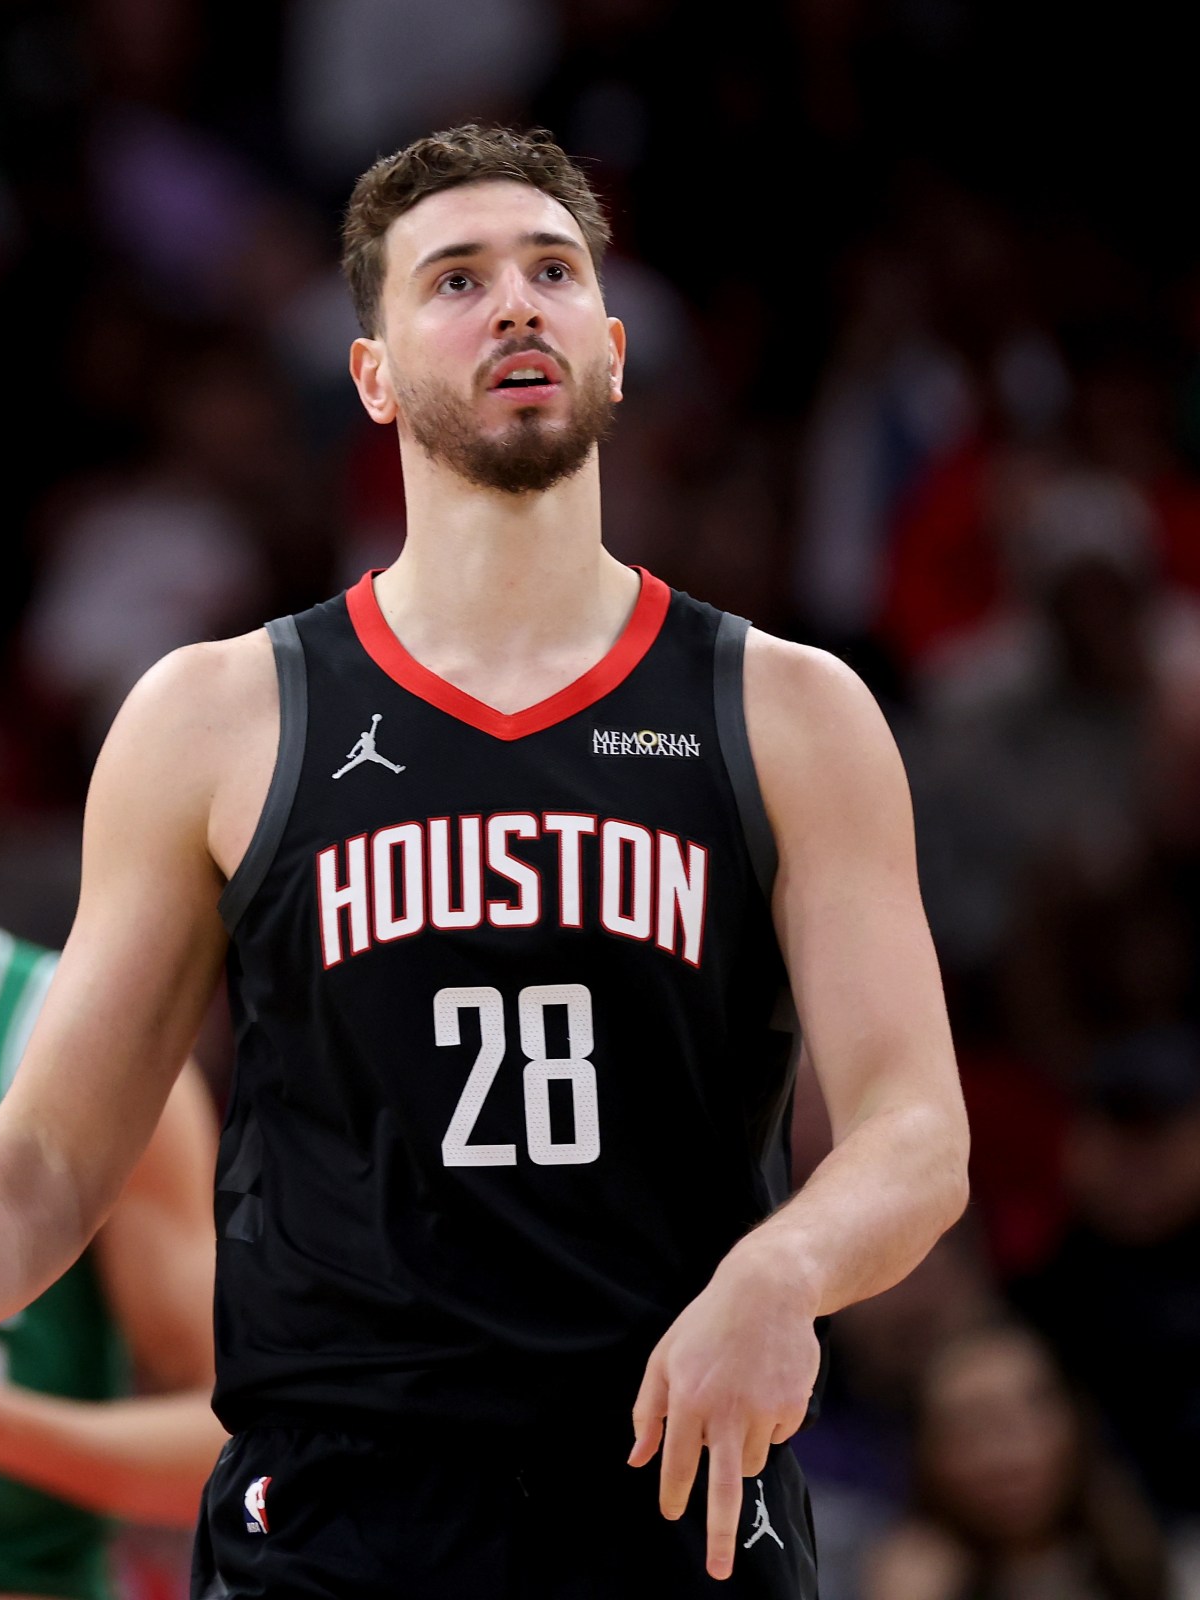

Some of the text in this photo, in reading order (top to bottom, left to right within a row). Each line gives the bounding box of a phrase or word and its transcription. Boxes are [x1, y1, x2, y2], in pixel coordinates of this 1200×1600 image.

[592, 728, 701, 747] MEMORIAL
[593, 740, 700, 757] HERMANN
[315, 811, 709, 970] HOUSTON
[433, 983, 601, 1167] 28
